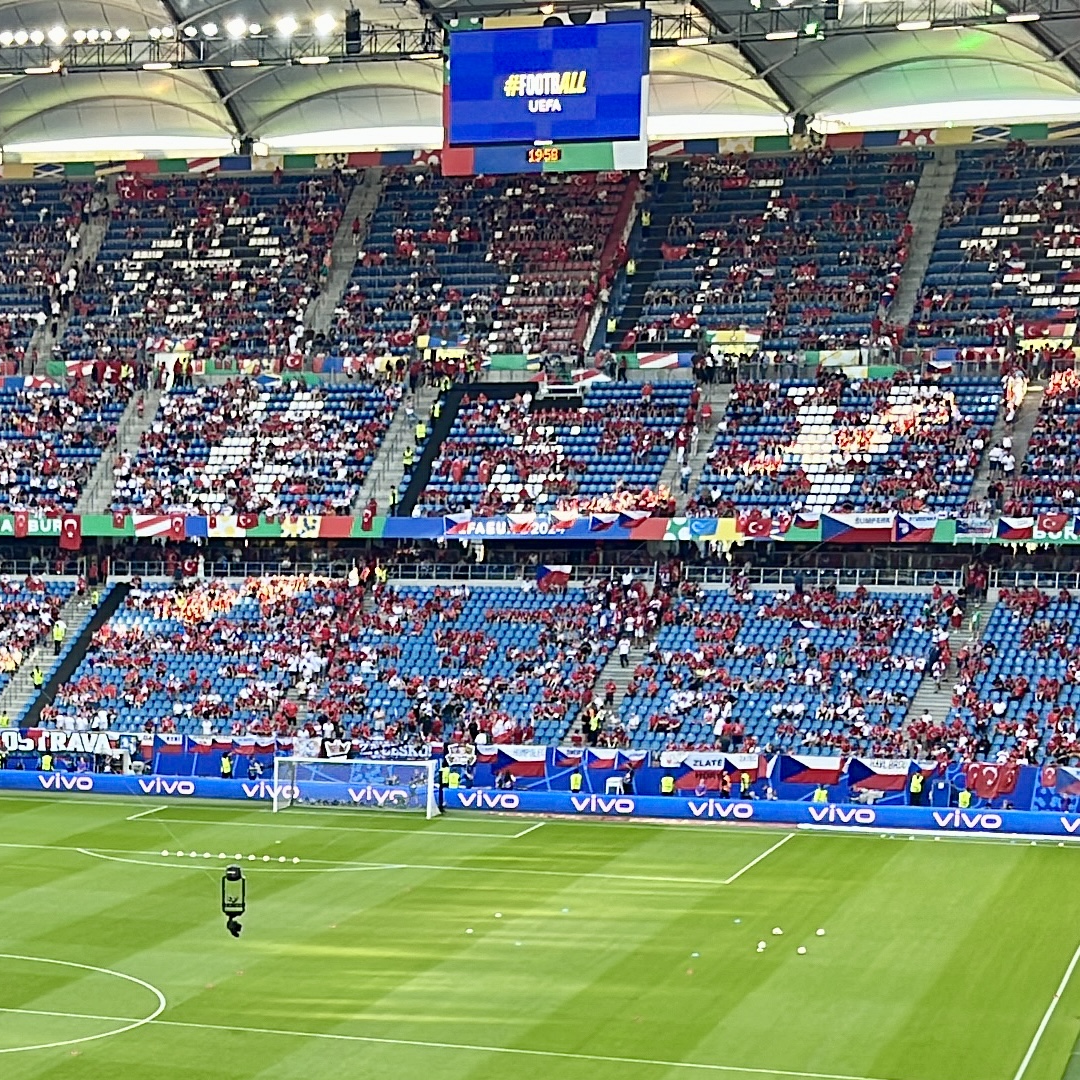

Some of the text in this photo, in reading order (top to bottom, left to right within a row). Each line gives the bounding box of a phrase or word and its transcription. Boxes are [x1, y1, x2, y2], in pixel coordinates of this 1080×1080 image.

[504, 71, 586, 97] #FOOTBALL
[528, 98, 561, 113] UEFA
[1, 730, 112, 753] OSTRAVA
[38, 773, 94, 791] vivo
[139, 777, 195, 795] vivo
[242, 781, 300, 799] vivo
[458, 790, 520, 809] vivo
[571, 794, 635, 814] vivo
[688, 799, 754, 819] vivo
[808, 804, 876, 823] vivo
[933, 809, 1002, 829] vivo
